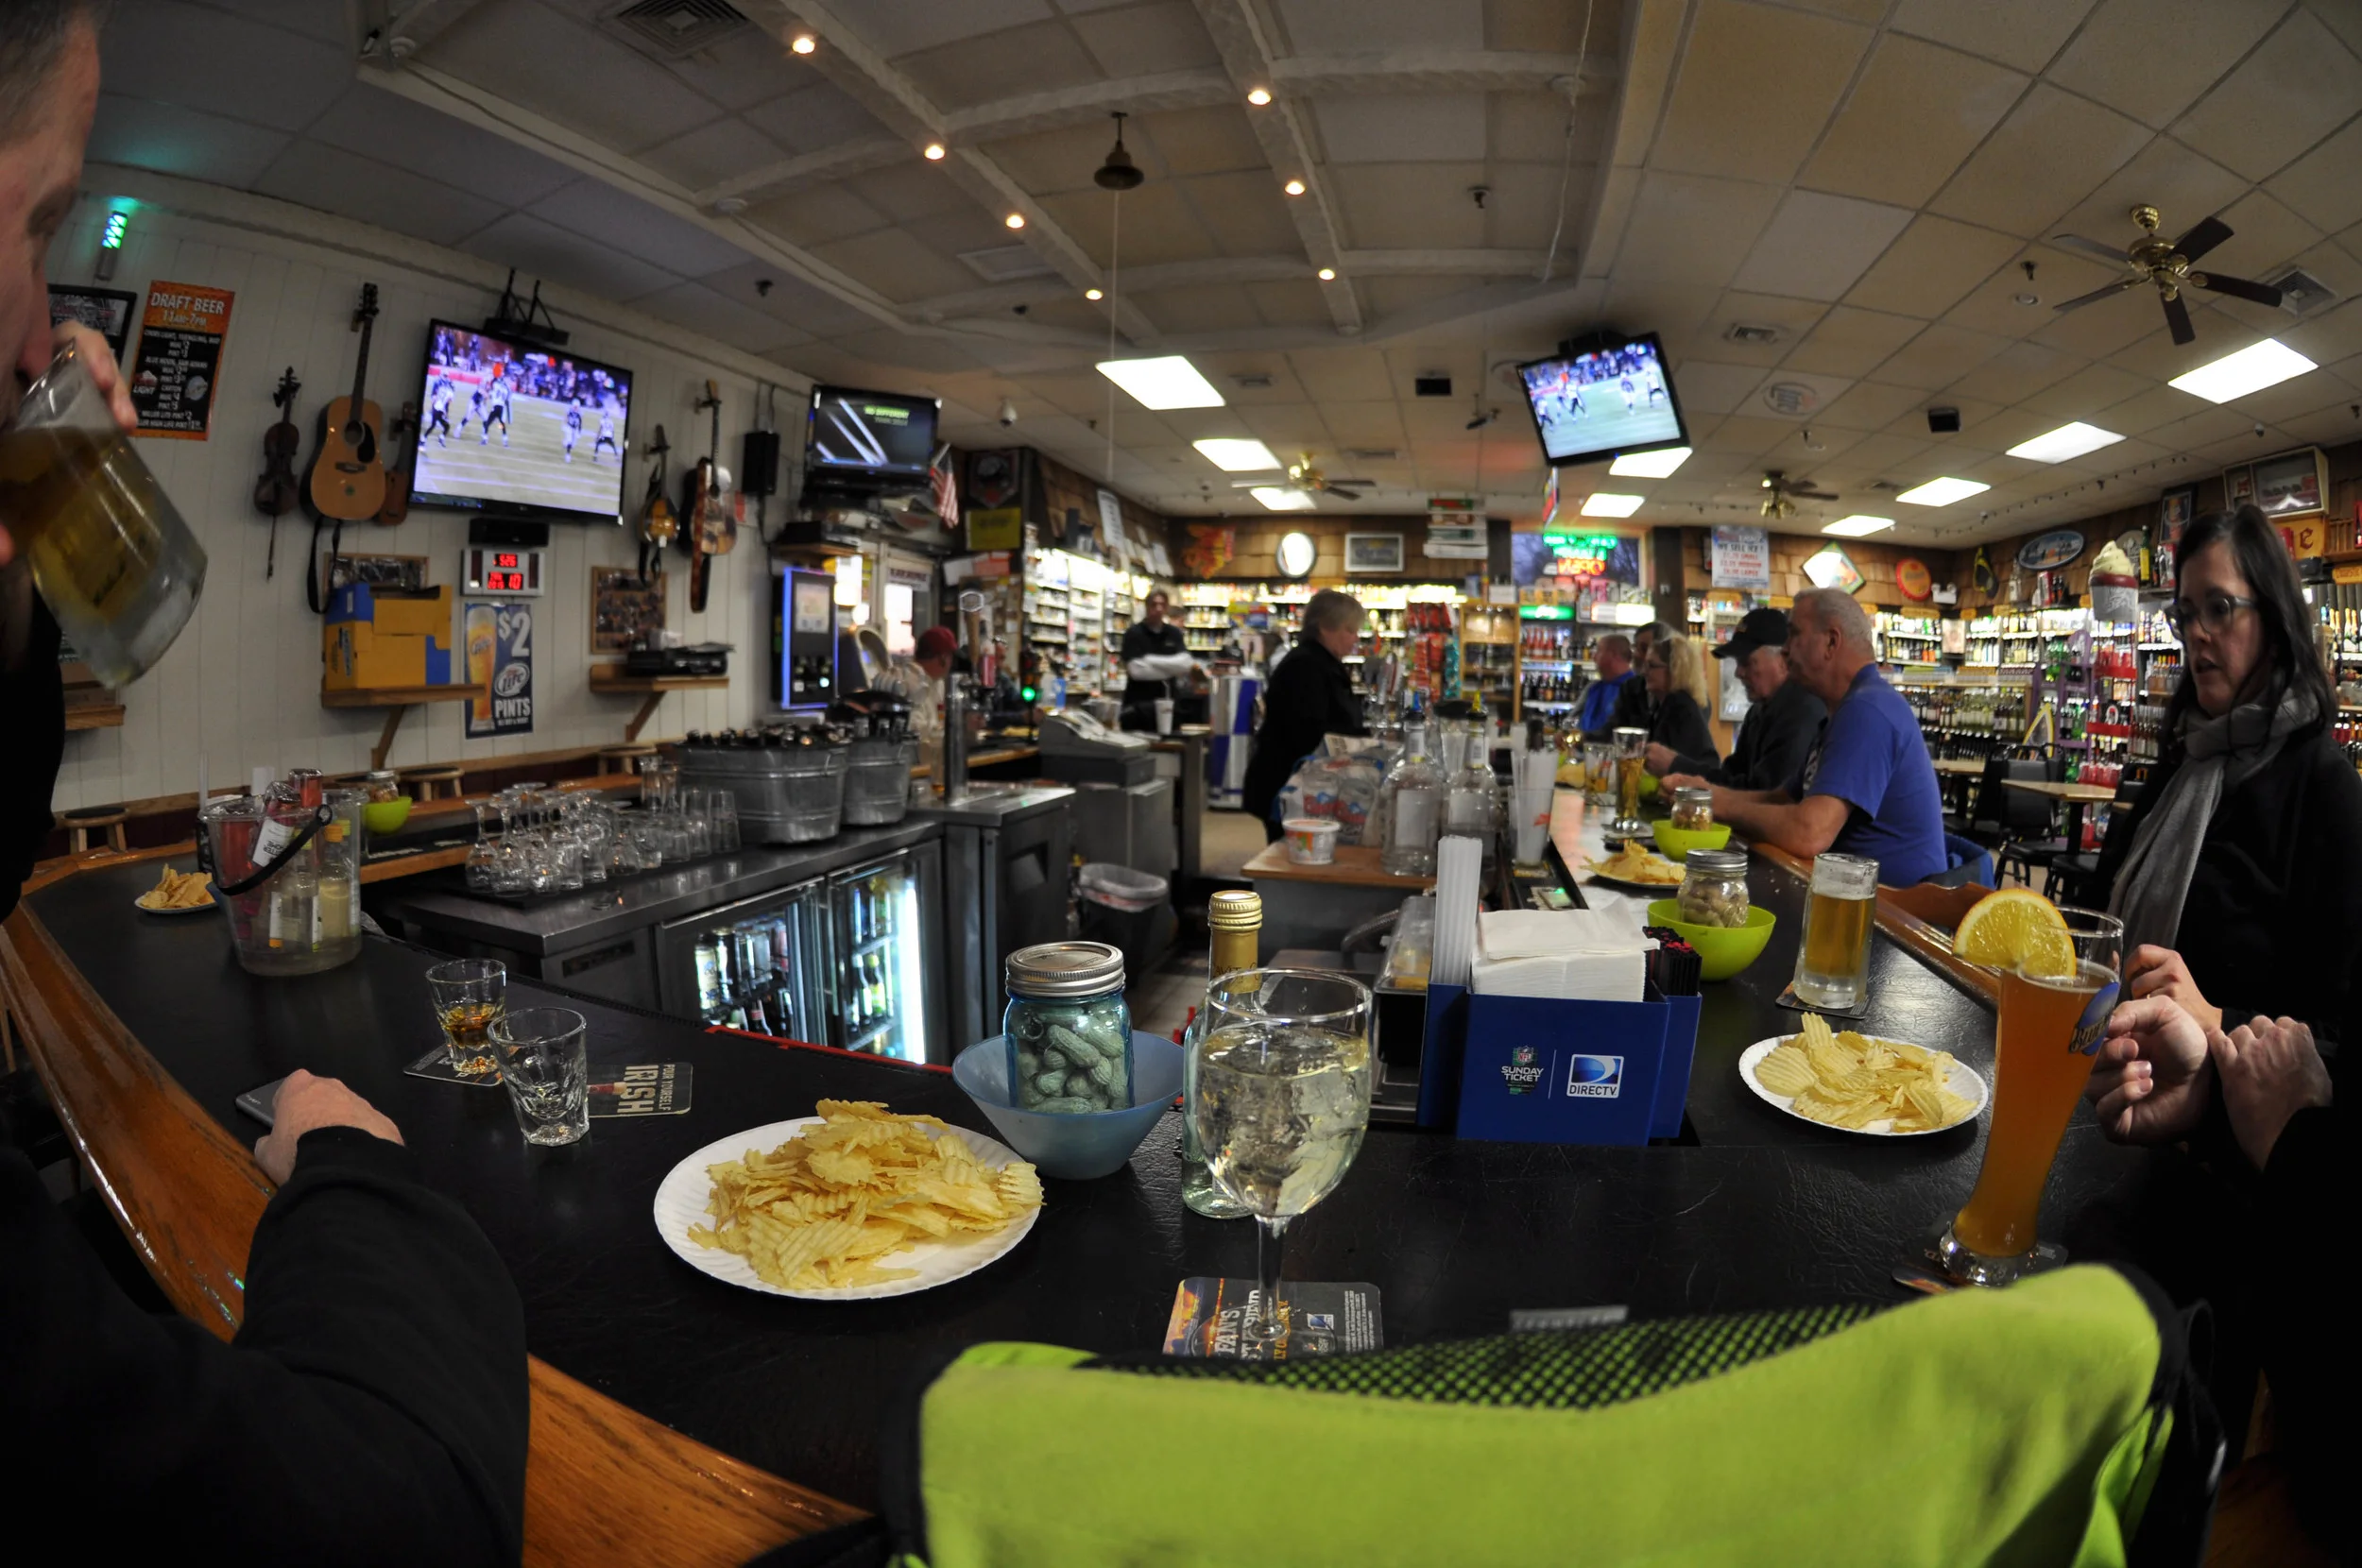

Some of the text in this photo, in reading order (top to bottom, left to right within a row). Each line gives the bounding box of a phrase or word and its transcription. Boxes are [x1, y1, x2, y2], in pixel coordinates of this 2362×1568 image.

[151, 292, 225, 314] DRAFT BEER
[498, 611, 531, 657] $2
[494, 698, 532, 720] PINTS
[1501, 1065, 1544, 1075] SUNDAY
[1504, 1073, 1540, 1082] TICKET
[617, 1065, 659, 1114] IRISH
[1569, 1084, 1617, 1096] DIRECTV
[1214, 1309, 1241, 1355] FAN'S
